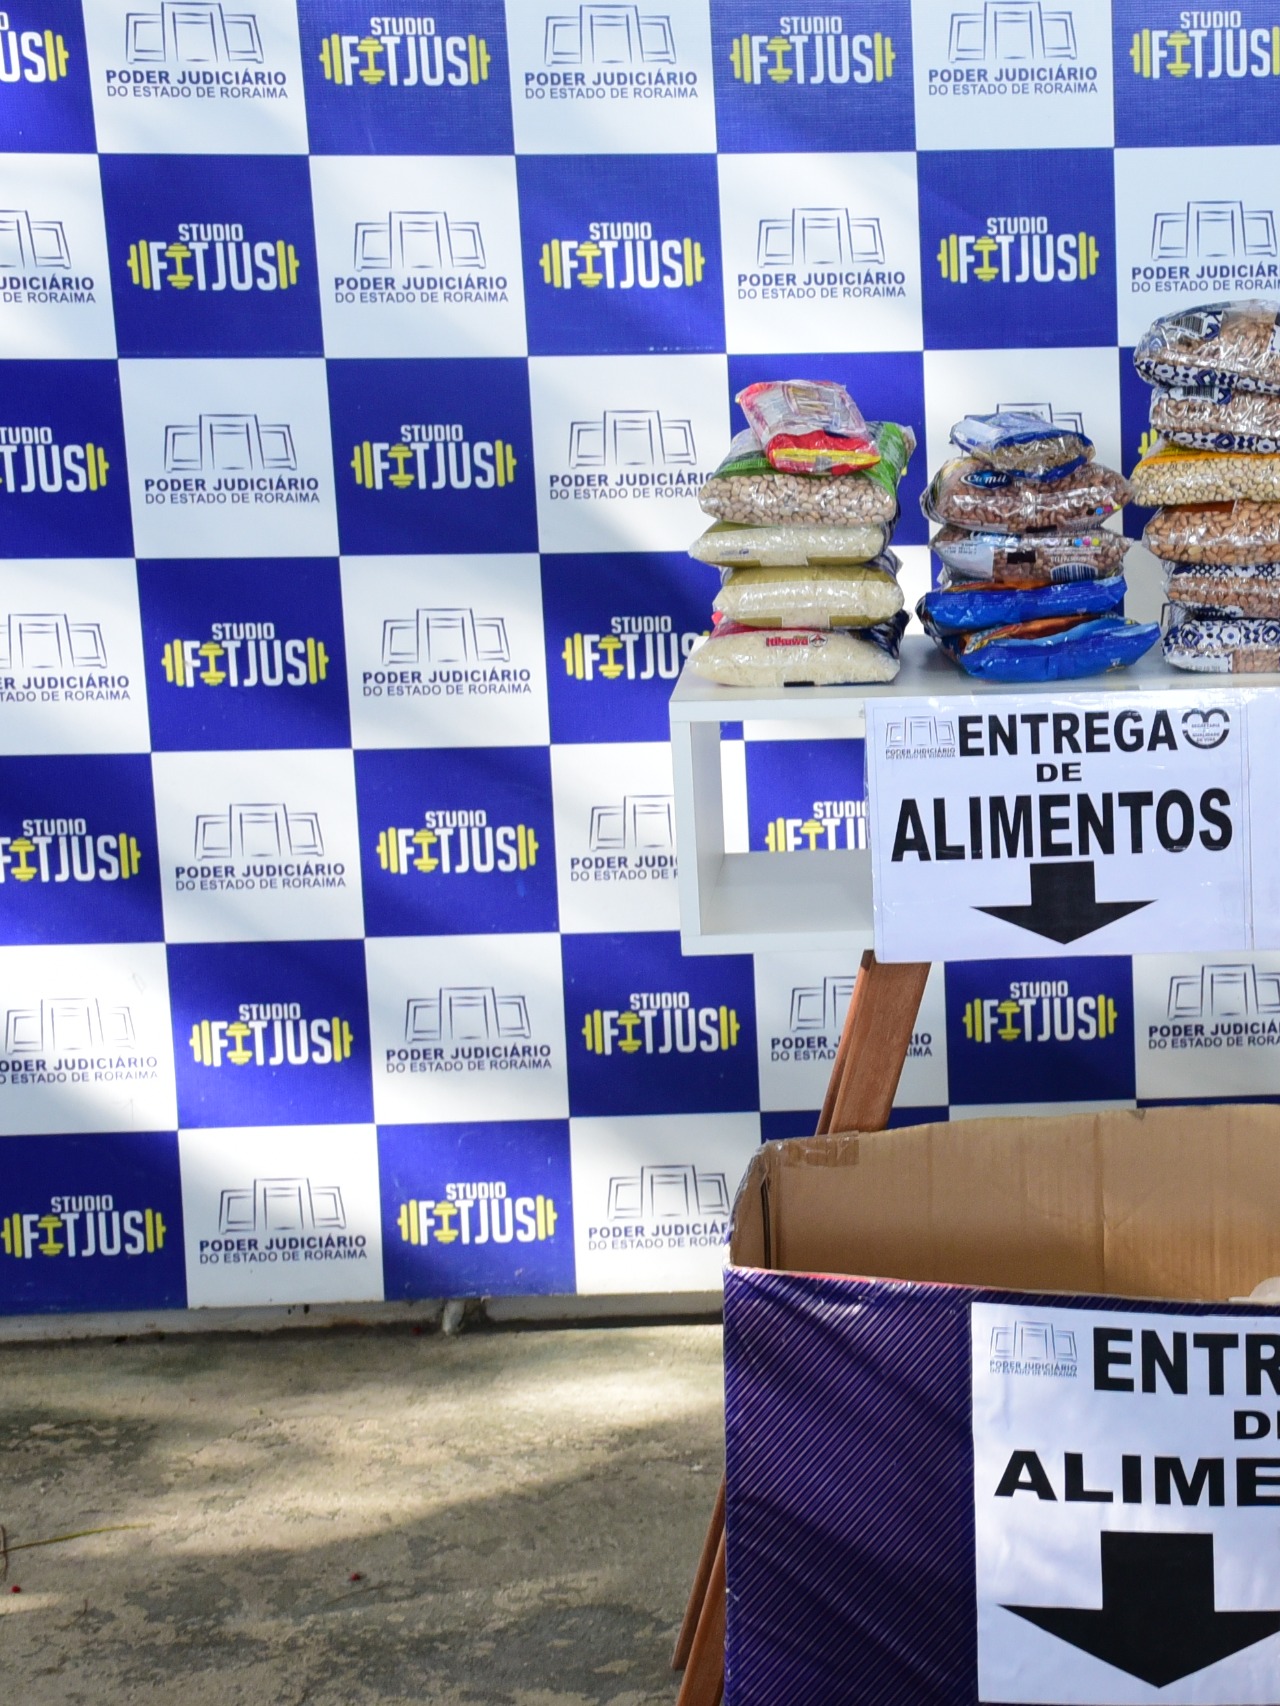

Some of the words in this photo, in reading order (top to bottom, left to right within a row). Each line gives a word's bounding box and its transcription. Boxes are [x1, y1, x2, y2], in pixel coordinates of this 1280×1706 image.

[371, 17, 435, 35] STUDIO
[780, 16, 842, 34] STUDIO
[1180, 11, 1241, 28] STUDIO
[106, 70, 171, 84] PODER
[177, 68, 286, 85] JUDICIÁRIO
[929, 69, 988, 83] PODER
[994, 63, 1097, 82] JUDICIÁRIO
[107, 85, 128, 97] DO
[133, 86, 191, 98] ESTADO
[196, 86, 215, 98] DE
[220, 87, 288, 98] RORAIMA
[929, 84, 948, 95] DO
[953, 84, 1007, 95] ESTADO
[1012, 83, 1029, 94] DE
[1034, 82, 1097, 94] RORAIMA
[179, 224, 243, 241] STUDIO
[590, 222, 651, 240] STUDIO
[987, 217, 1047, 235] STUDIO
[738, 273, 797, 286] PODER
[803, 268, 905, 286] JUDICIÁRIO
[738, 289, 757, 299] DO
[762, 288, 816, 299] ESTADO
[821, 287, 837, 298] DE
[843, 286, 906, 297] RORAIMA
[401, 425, 463, 442] STUDIO
[144, 478, 207, 494] PODER
[213, 474, 319, 493] JUDICIÁRIO
[145, 493, 165, 504] DO
[170, 493, 226, 504] ESTADO
[231, 493, 249, 503] DE
[254, 492, 320, 503] RORAIMA
[212, 623, 274, 640] STUDIO
[363, 671, 422, 685] PODER
[428, 665, 530, 683] JUDICIÁRIO
[363, 685, 382, 696] DO
[387, 685, 441, 696] ESTADO
[446, 684, 463, 695] DE
[469, 683, 531, 694] RORAIMA
[960, 709, 1178, 756] ENTREGA
[1037, 763, 1081, 782] DE
[23, 819, 86, 836] STUDIO
[426, 810, 486, 828] STUDIO
[891, 787, 1234, 862] ALIMENTOS
[1010, 981, 1068, 998] STUDIO
[630, 992, 689, 1010] STUDIO
[239, 1004, 300, 1020] STUDIO
[386, 1048, 444, 1062] PODER
[450, 1042, 551, 1060] JUDICIÁRIO
[386, 1061, 405, 1073] DO
[410, 1059, 463, 1072] ESTADO
[468, 1059, 484, 1070] DE
[487, 1057, 552, 1070] RORAIMA
[446, 1182, 506, 1198] STUDIO
[51, 1195, 113, 1212] STUDIO
[199, 1239, 258, 1254] PODER
[265, 1232, 366, 1251] JUDICIÁRIO
[200, 1253, 219, 1264] DO
[224, 1250, 277, 1263] ESTADO
[282, 1250, 299, 1261] DE
[304, 1247, 367, 1260] RORAIMA
